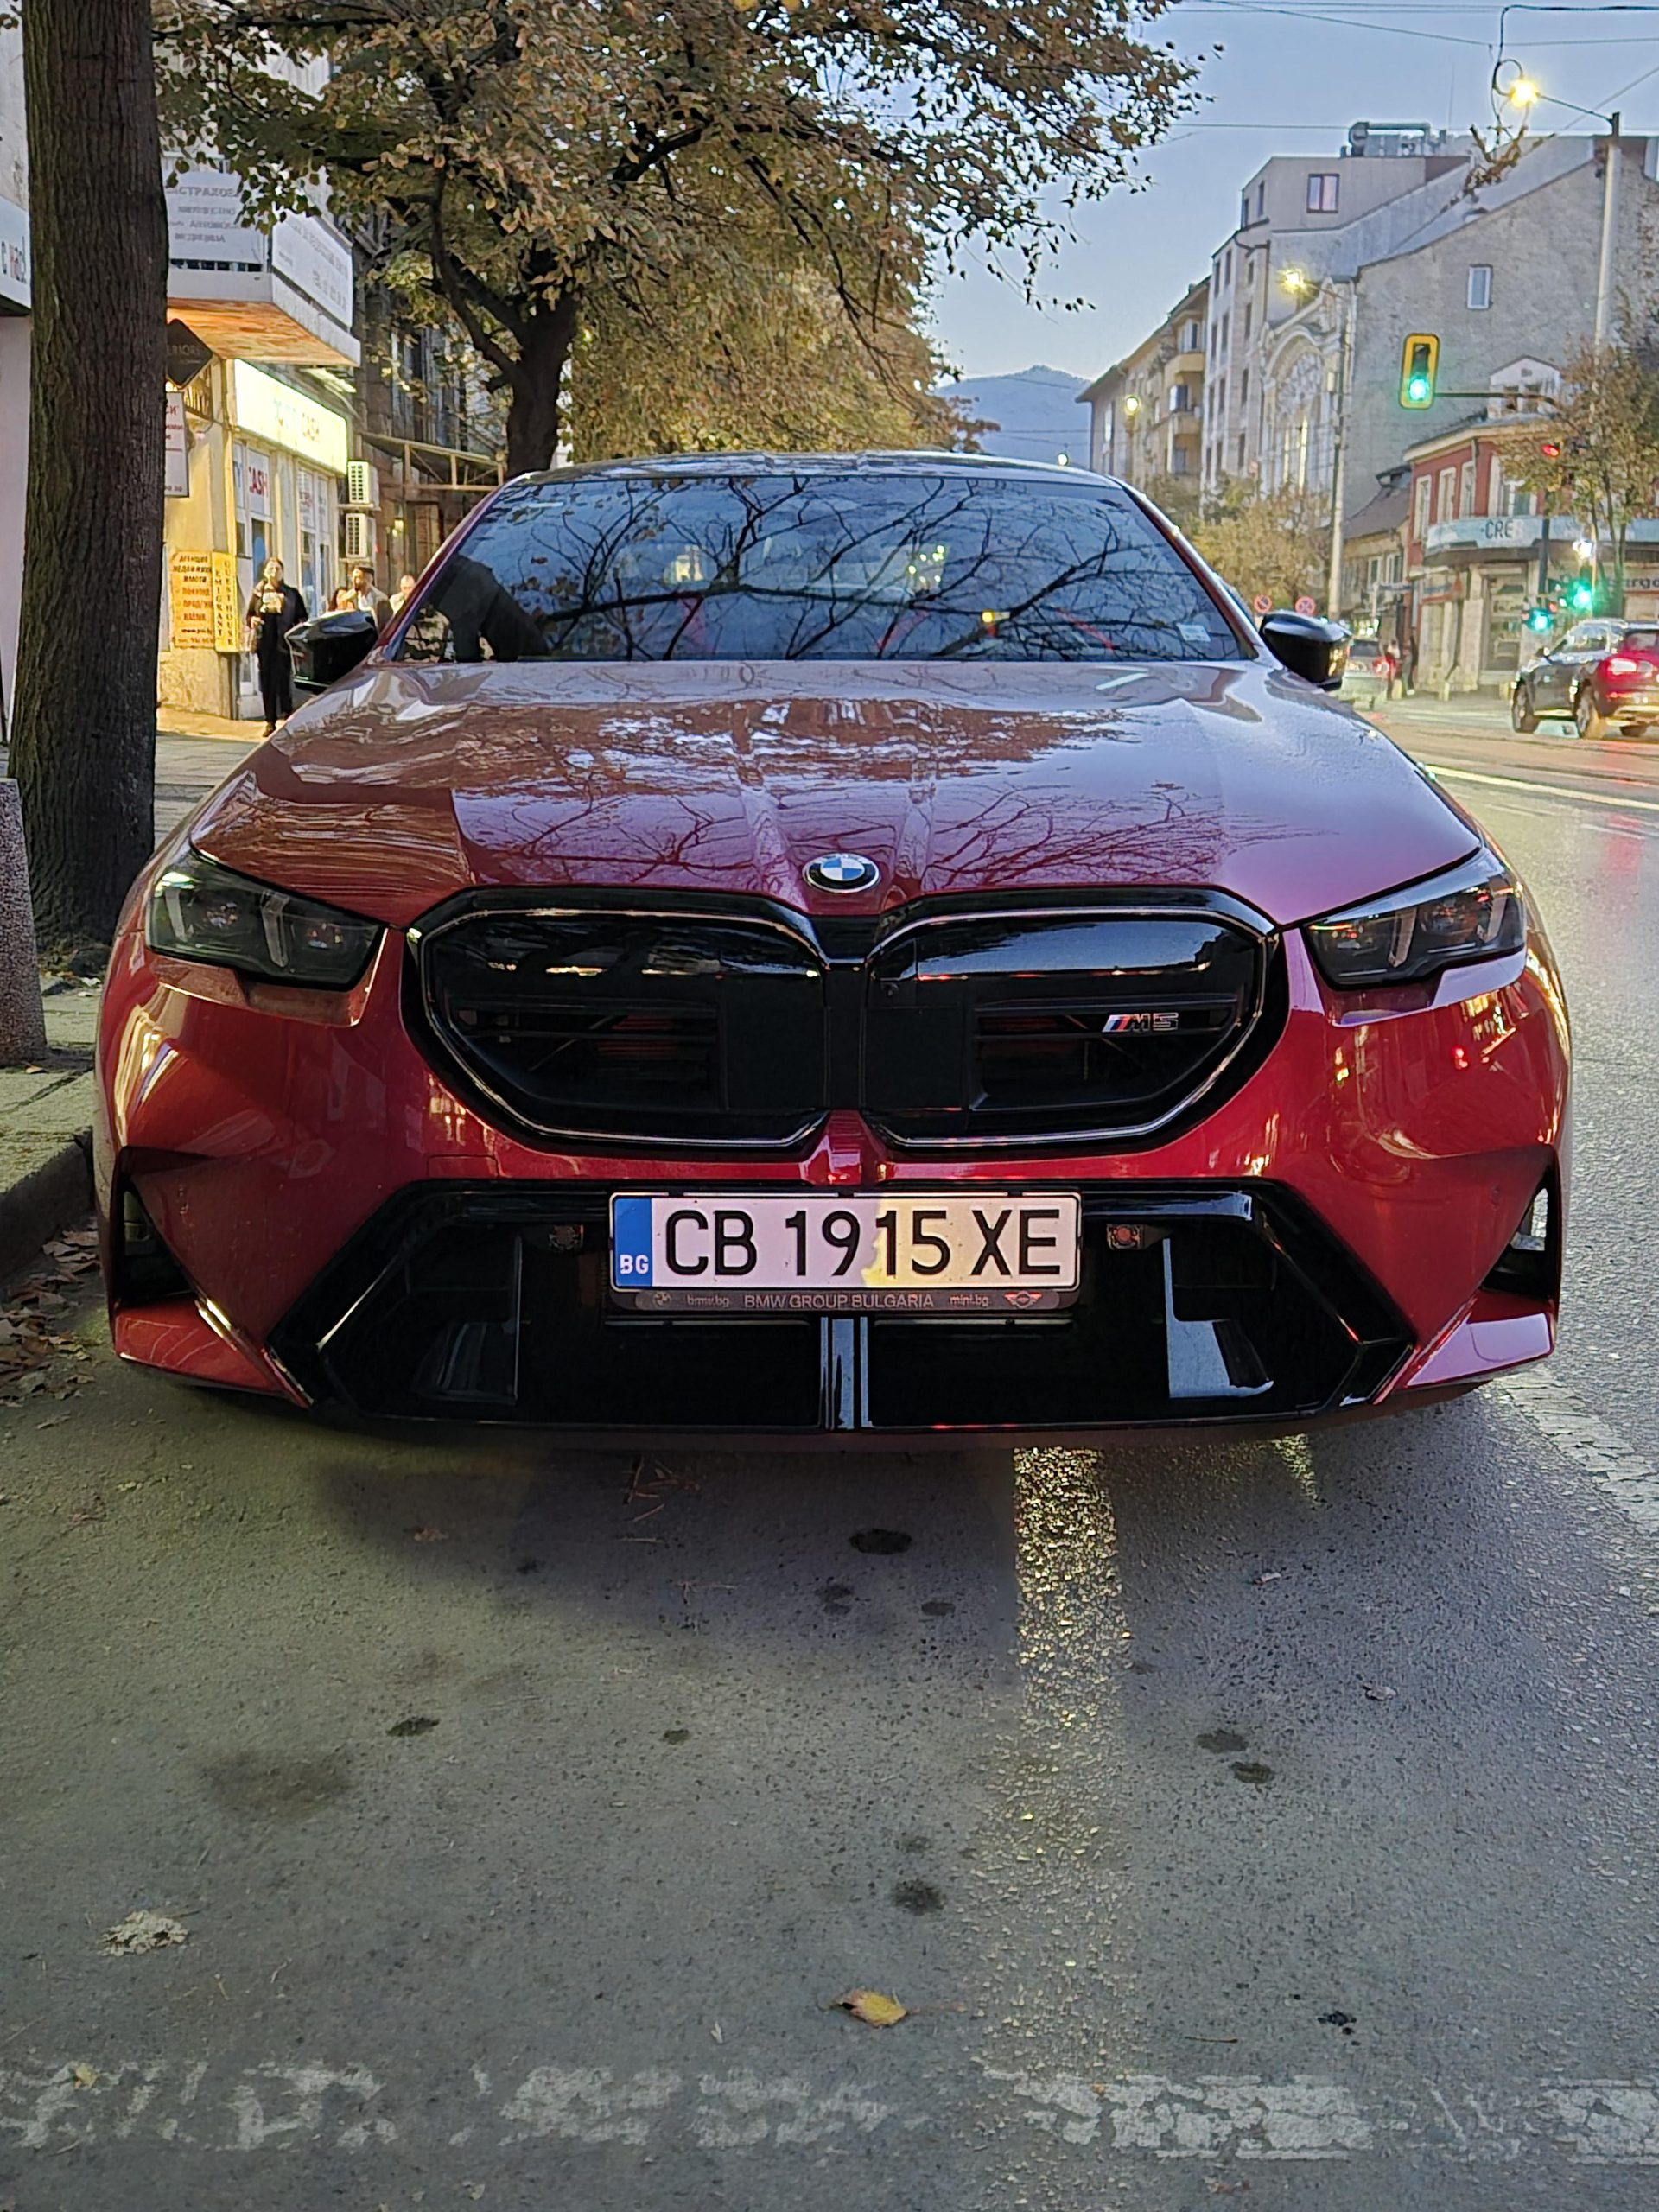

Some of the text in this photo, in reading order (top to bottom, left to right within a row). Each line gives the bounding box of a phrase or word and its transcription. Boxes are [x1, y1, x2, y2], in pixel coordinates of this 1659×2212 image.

[665, 1209, 1062, 1277] CB 1915 XE
[619, 1255, 650, 1275] BG
[744, 1295, 785, 1309] BMW
[788, 1295, 848, 1309] GROUP
[851, 1295, 935, 1309] BULGARIA
